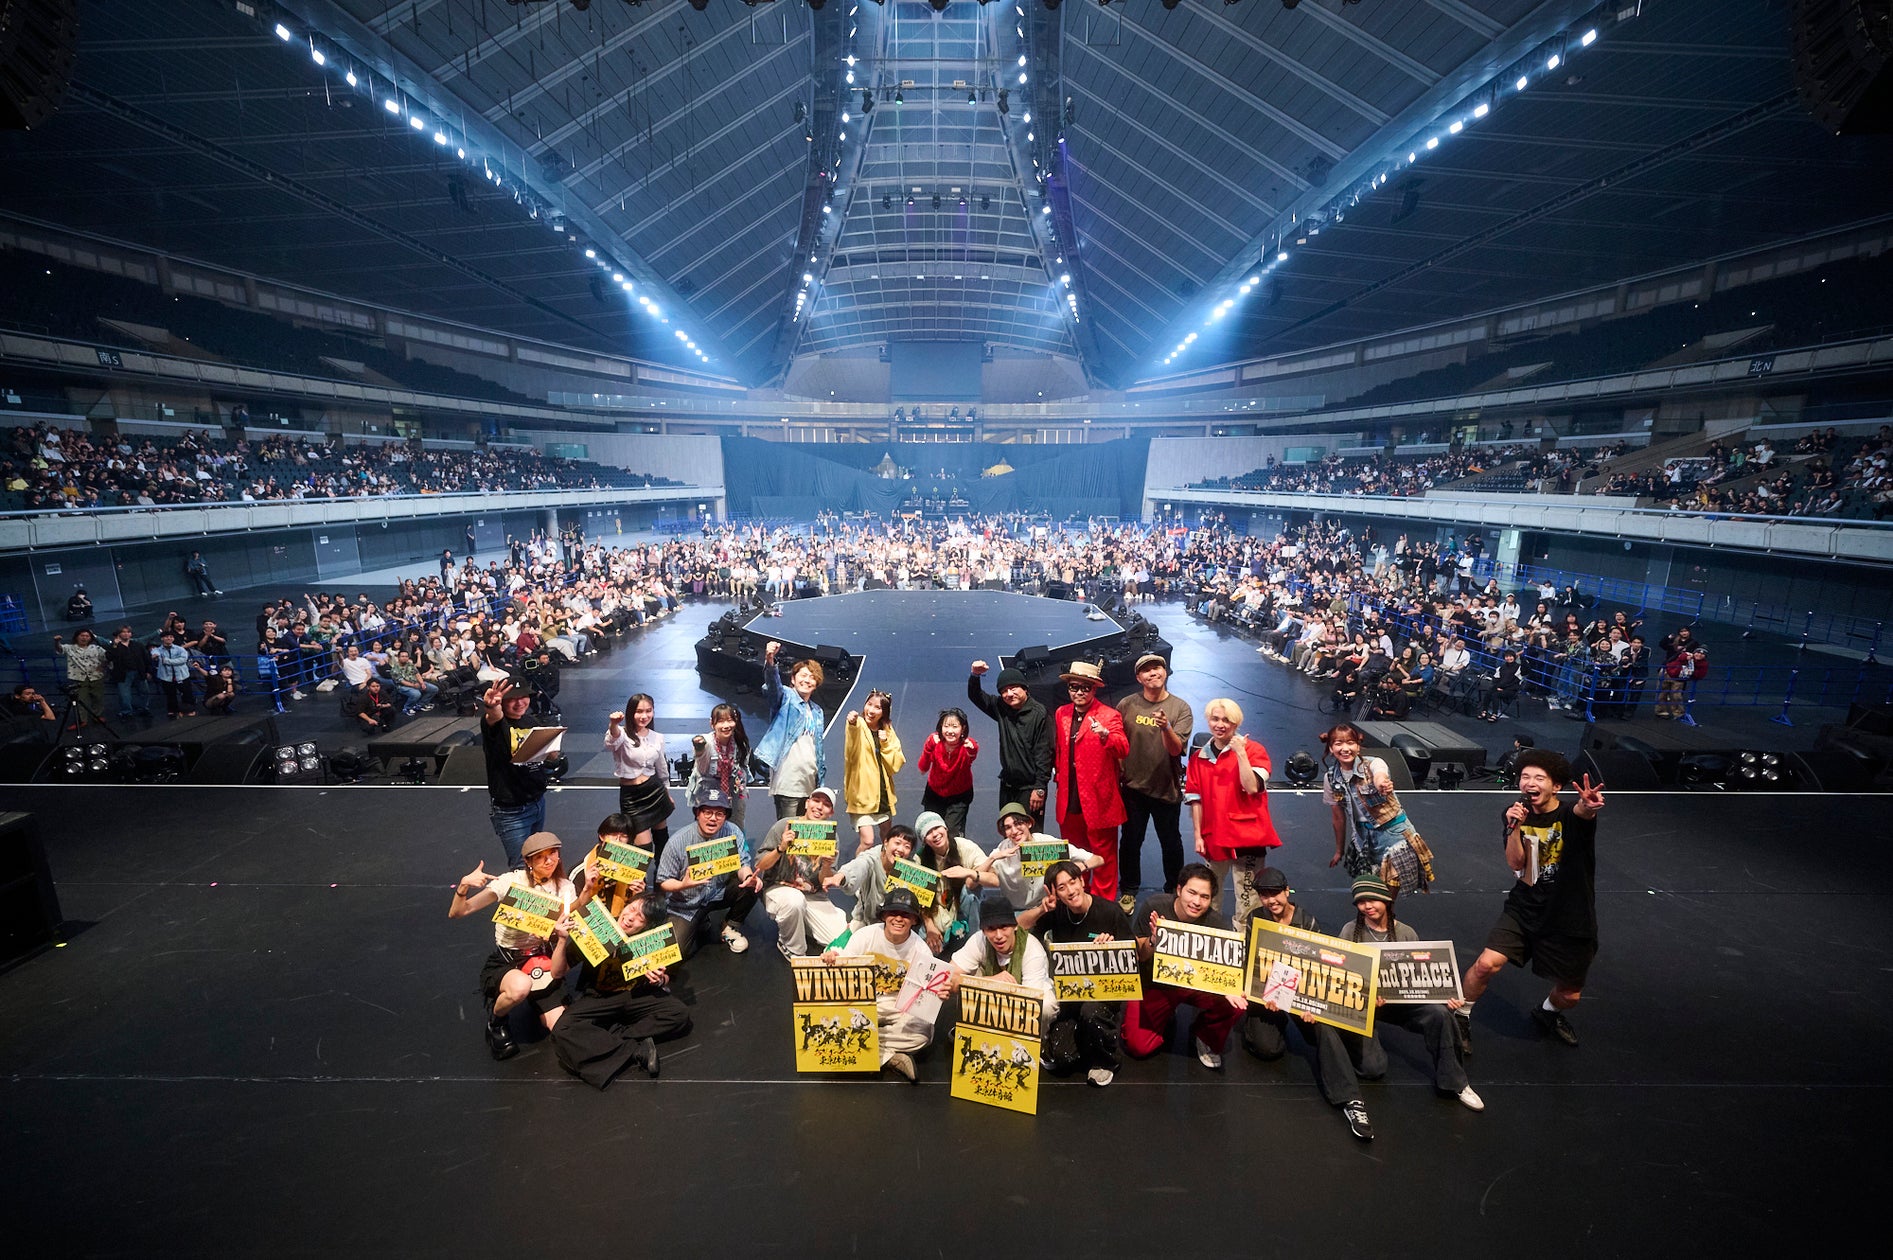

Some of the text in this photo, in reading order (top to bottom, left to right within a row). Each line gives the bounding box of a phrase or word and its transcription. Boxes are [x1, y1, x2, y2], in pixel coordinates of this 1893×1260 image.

[1053, 950, 1138, 974] 2nd PLACE
[1156, 928, 1189, 958] 2nd
[1191, 934, 1242, 967] PLACE
[793, 967, 875, 1000] WINNER
[1258, 947, 1364, 1011] WNNER
[1378, 962, 1453, 988] nd PLACE
[960, 987, 1041, 1036] WINNER
